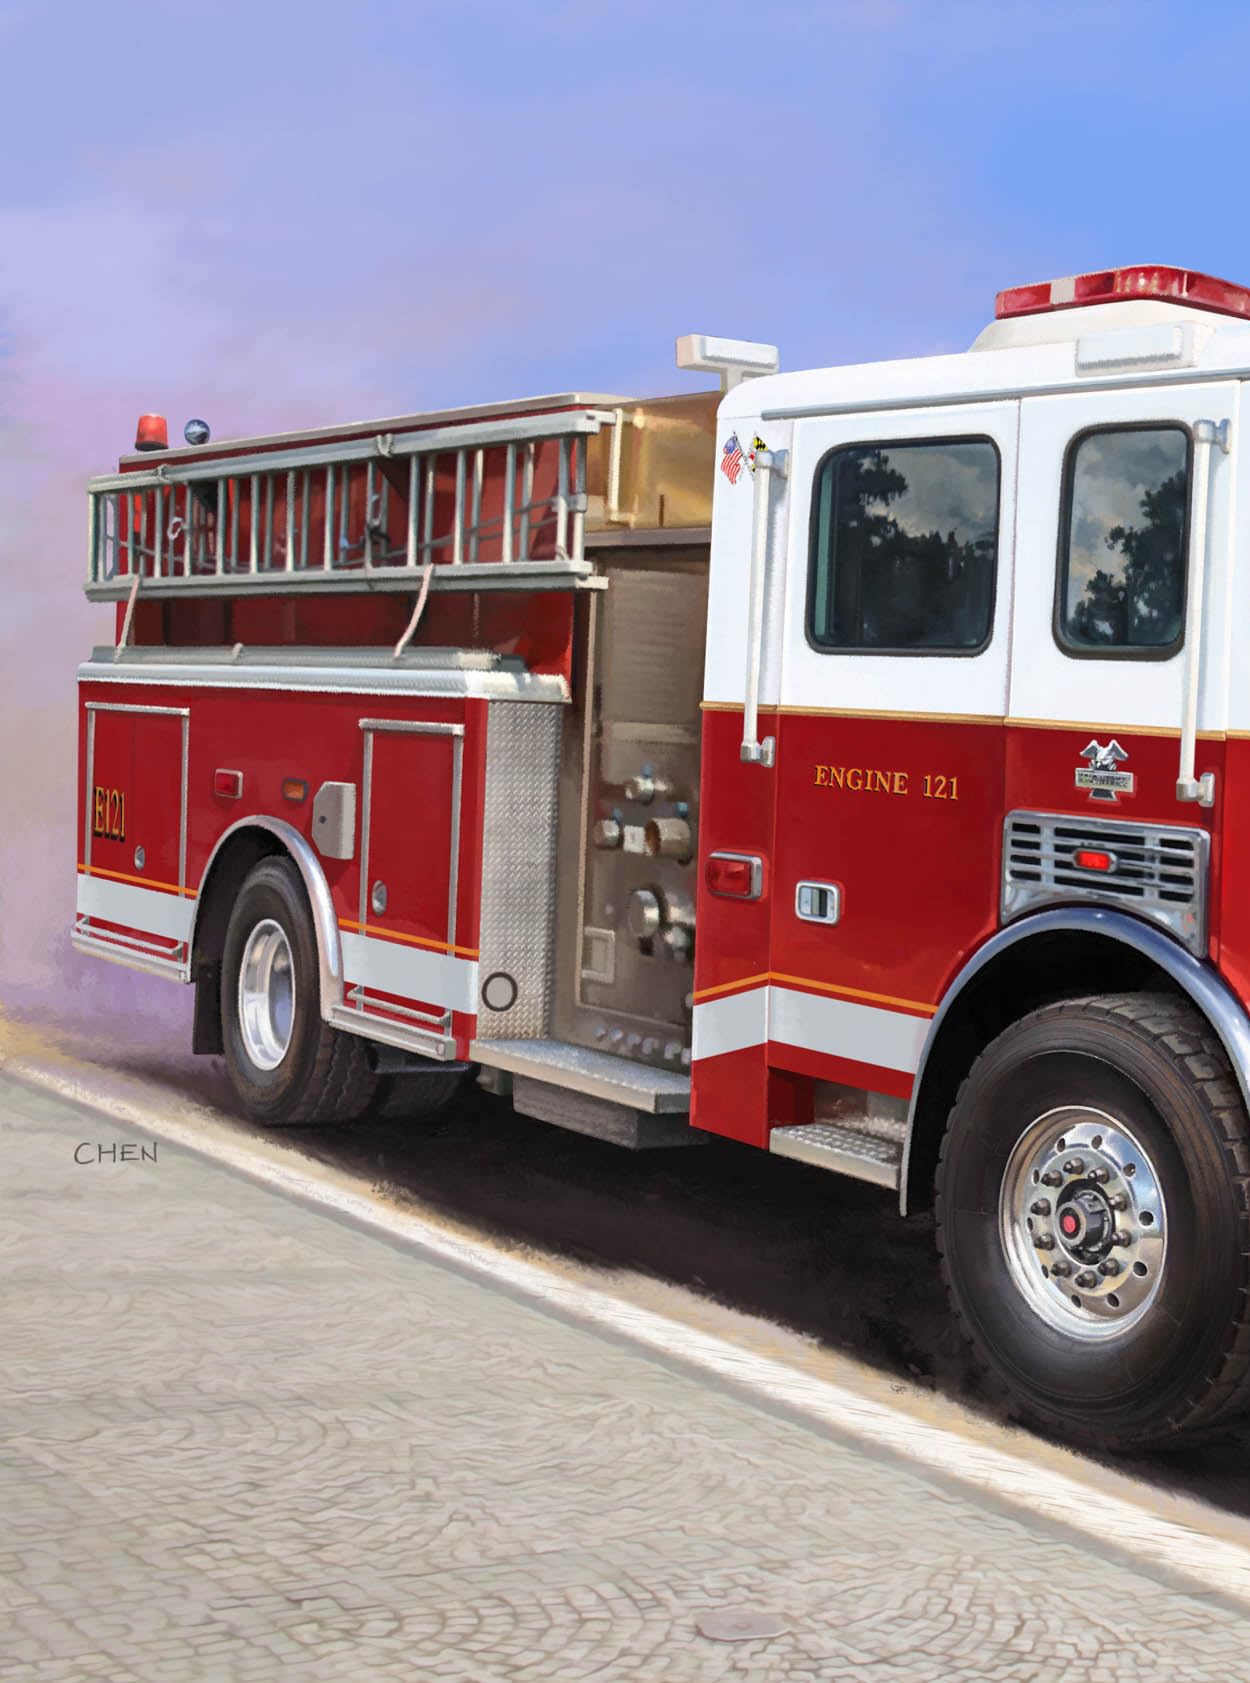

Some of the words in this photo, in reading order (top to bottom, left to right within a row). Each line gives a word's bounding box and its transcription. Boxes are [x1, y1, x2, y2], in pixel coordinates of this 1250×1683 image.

[814, 765, 909, 795] ENGINE
[922, 774, 959, 800] 121
[93, 785, 125, 843] E121
